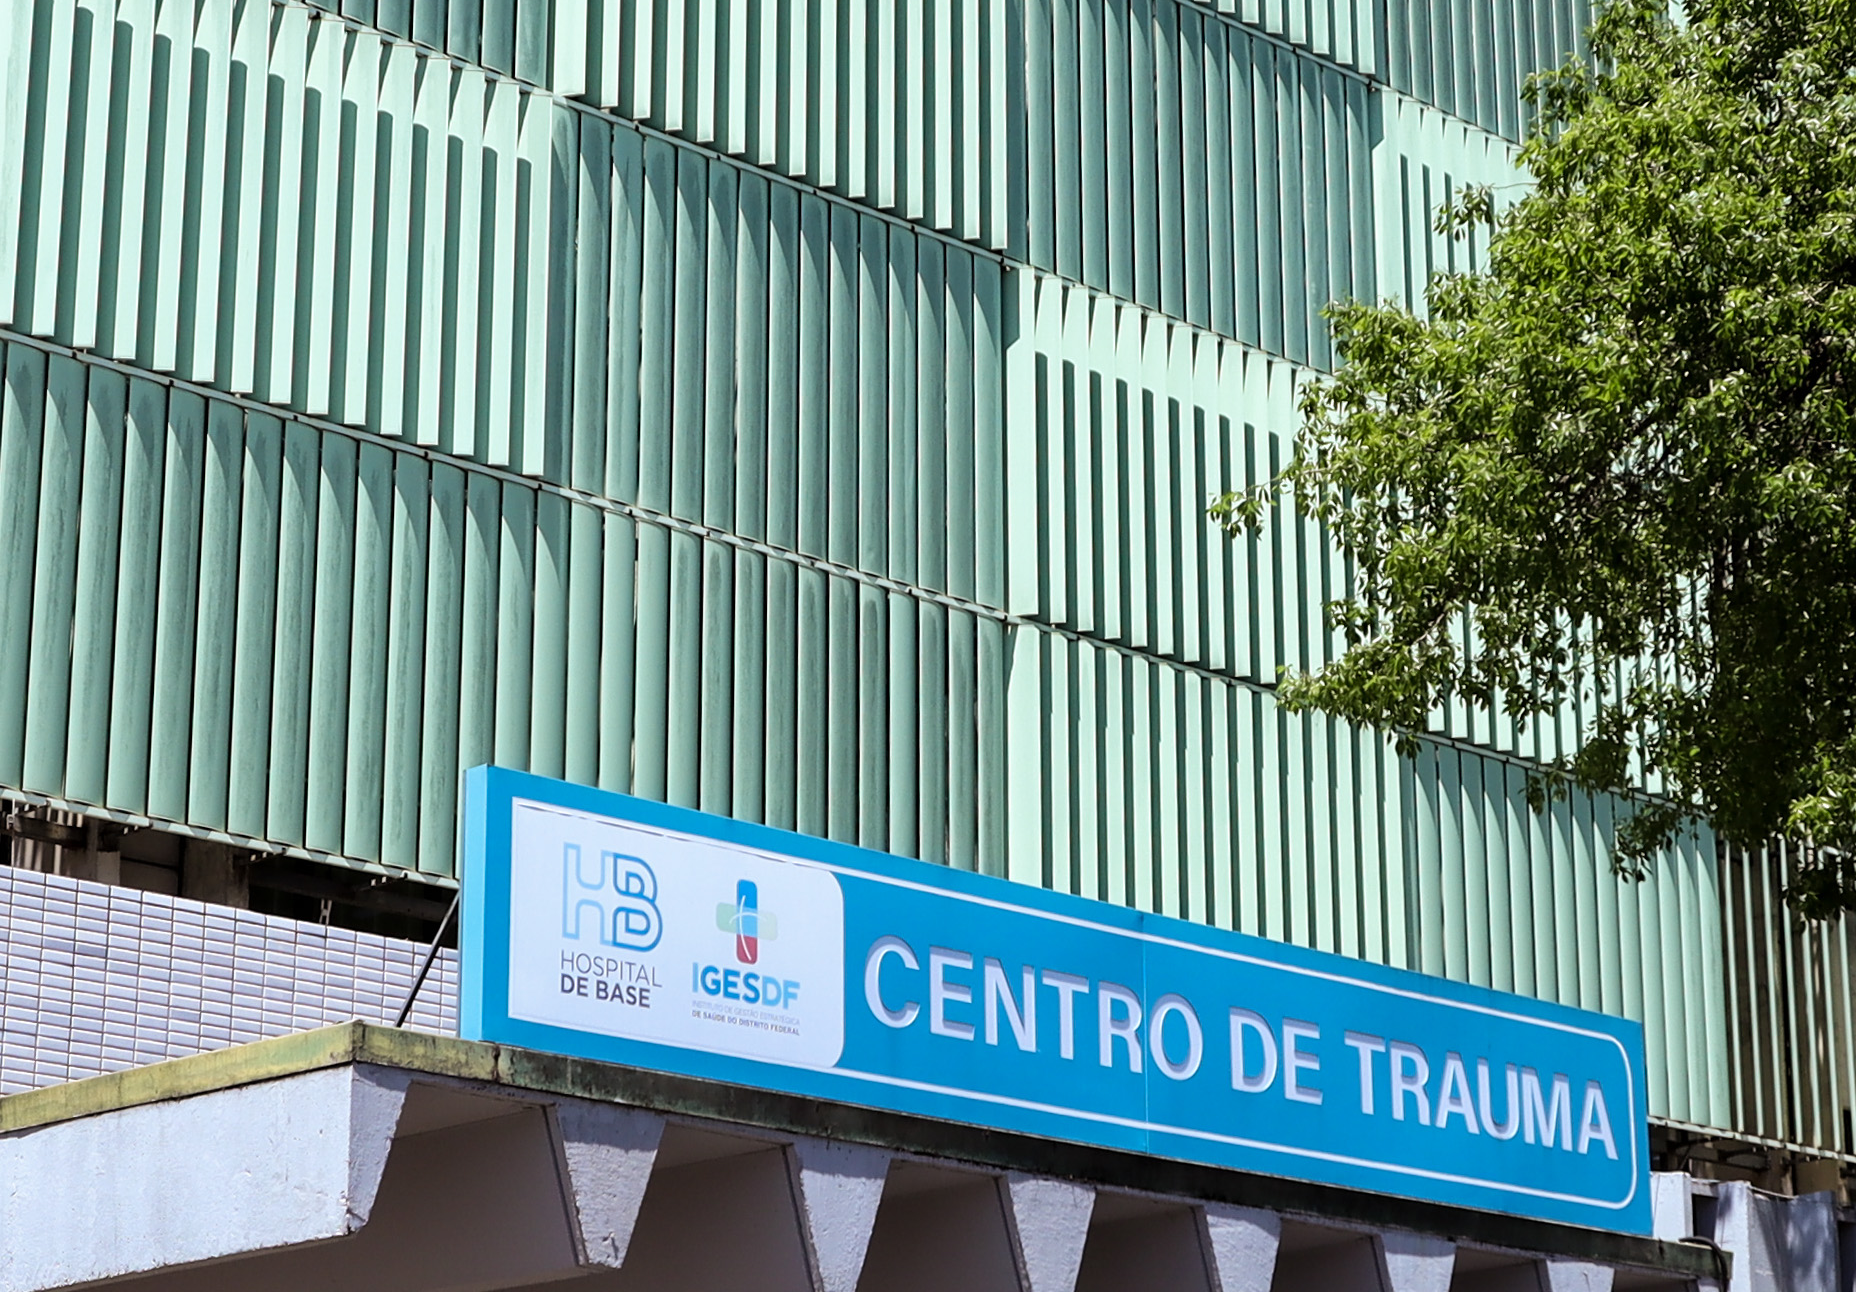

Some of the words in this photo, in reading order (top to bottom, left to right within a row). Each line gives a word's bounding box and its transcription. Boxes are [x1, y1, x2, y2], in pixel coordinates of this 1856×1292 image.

[560, 950, 663, 988] HOSPITAL
[691, 962, 801, 1010] IGESDF
[560, 973, 589, 999] DE
[595, 979, 651, 1009] BASE
[691, 1010, 701, 1018] DE
[727, 1016, 737, 1025] DO
[738, 1018, 769, 1031] DISTRITO
[770, 1024, 800, 1036] FEDERAL
[863, 935, 1204, 1081] CENTRO
[1228, 1006, 1323, 1106] DE
[1344, 1032, 1619, 1161] TRAUMA
